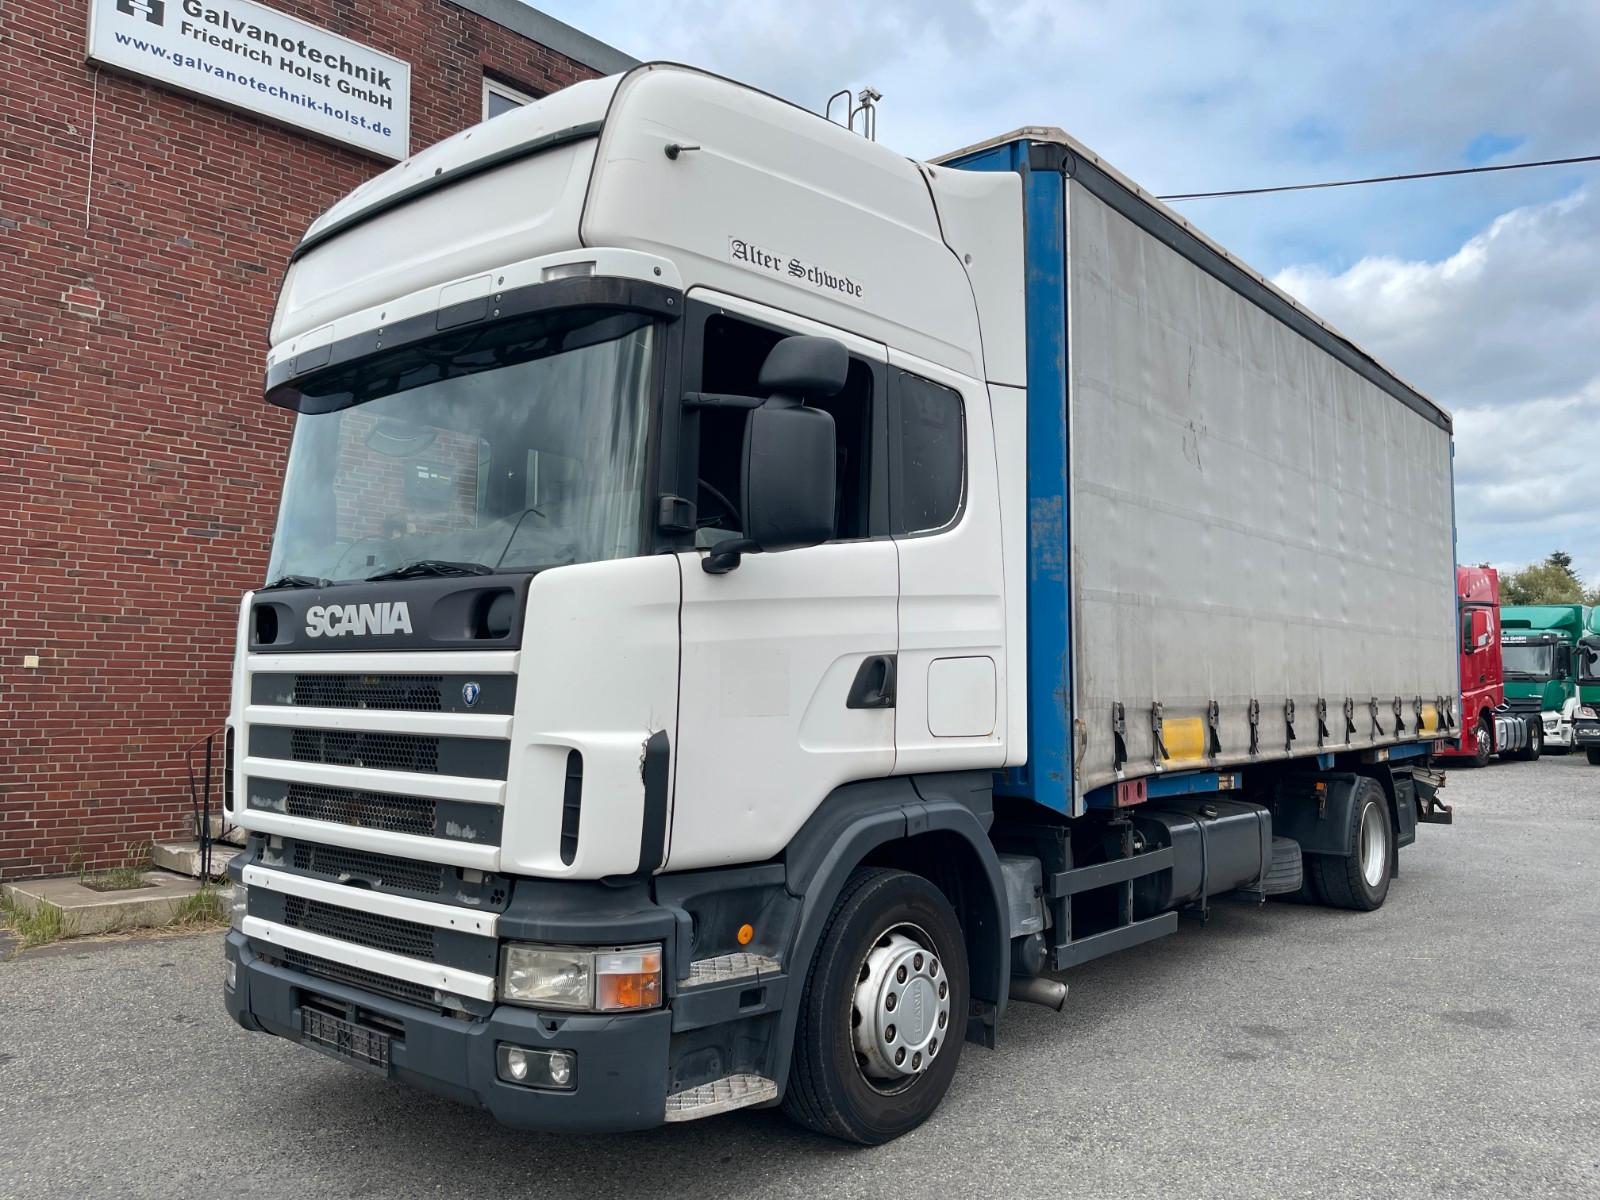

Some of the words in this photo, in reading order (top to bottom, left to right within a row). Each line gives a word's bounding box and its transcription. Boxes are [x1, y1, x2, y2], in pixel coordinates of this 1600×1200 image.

[115, 32, 392, 136] www.galvanotechnik-holst.de
[181, 21, 272, 66] Friedrich
[280, 57, 331, 88] Holst
[337, 79, 392, 110] GmbH
[182, 0, 392, 91] Galvanotechnik
[732, 240, 782, 271] Alter
[788, 258, 863, 298] Schwede
[305, 601, 413, 638] SCANIA
